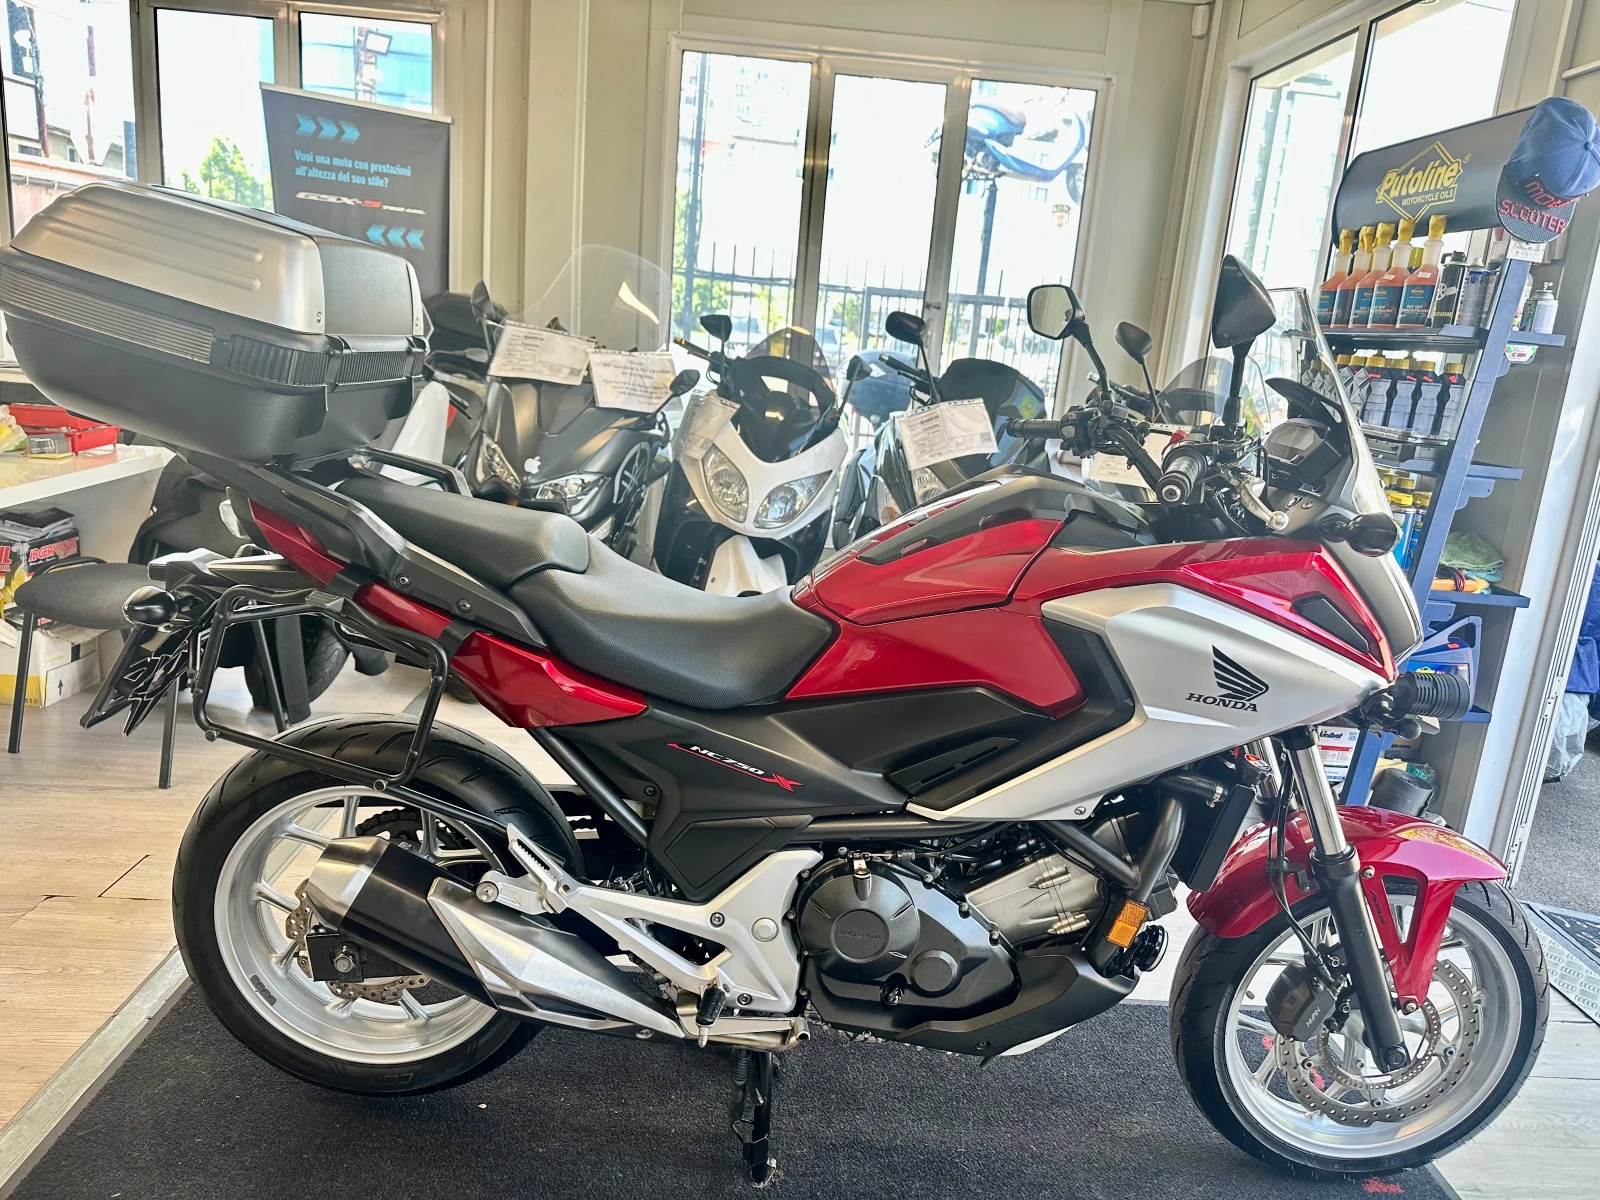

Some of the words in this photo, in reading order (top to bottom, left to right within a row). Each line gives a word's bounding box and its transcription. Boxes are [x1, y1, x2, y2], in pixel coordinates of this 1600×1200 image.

[294, 149, 314, 163] Vuoi
[315, 154, 331, 165] una
[332, 156, 353, 169] moto
[354, 160, 369, 171] con
[370, 162, 412, 177] prestazioni
[295, 165, 336, 181] all'altezza
[337, 170, 350, 183] del
[351, 174, 367, 185] suo
[367, 176, 389, 188] stile?
[1377, 159, 1460, 200] Putoline
[1401, 192, 1440, 206] MOTORCYCLE
[1440, 189, 1454, 199] OILS
[1500, 199, 1566, 234] SCOOTER
[28, 547, 41, 562] JB
[1185, 692, 1258, 713] HONDA
[837, 928, 884, 942] HONDA
